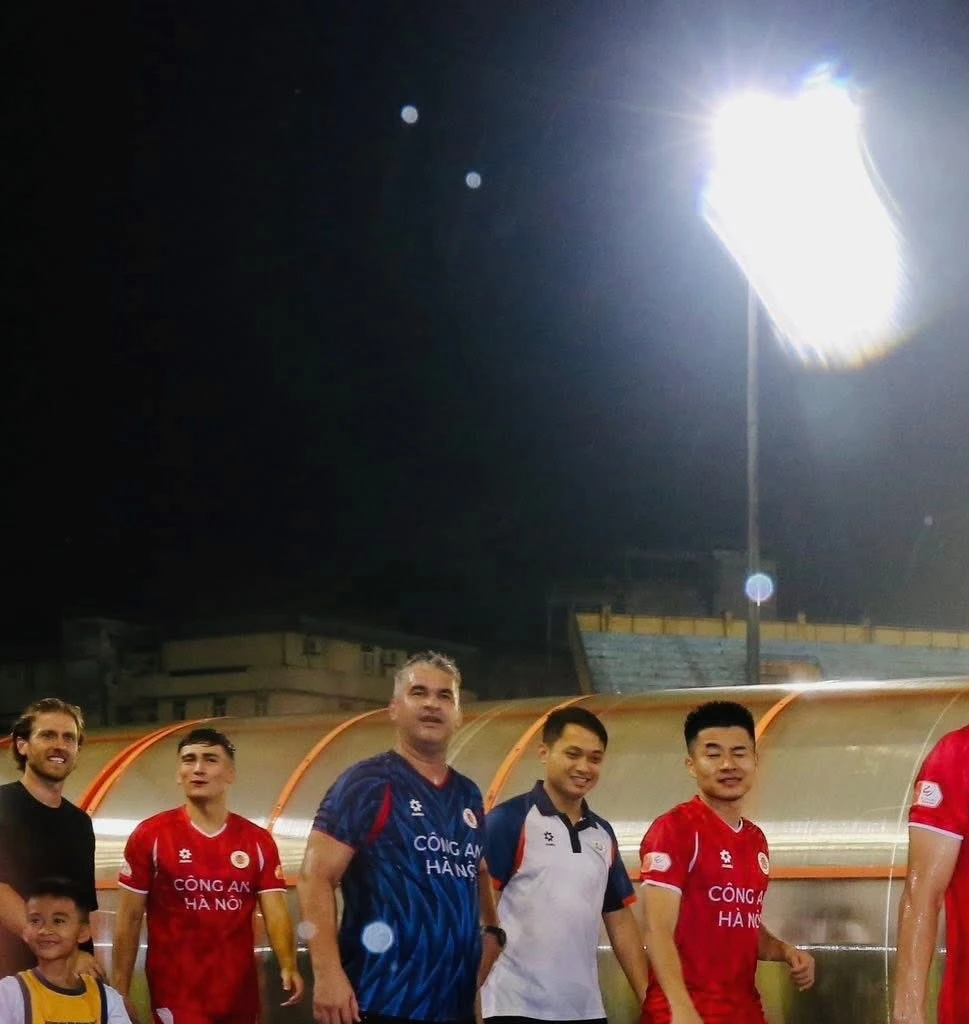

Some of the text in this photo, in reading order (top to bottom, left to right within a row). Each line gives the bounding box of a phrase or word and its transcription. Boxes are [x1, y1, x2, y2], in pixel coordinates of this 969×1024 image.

[414, 832, 460, 856] CÔNG
[426, 856, 454, 876] HÀ
[174, 875, 250, 892] CÔNG AN
[708, 882, 754, 904] CÔNG
[184, 894, 210, 910] HÀ
[718, 908, 743, 927] HÀ
